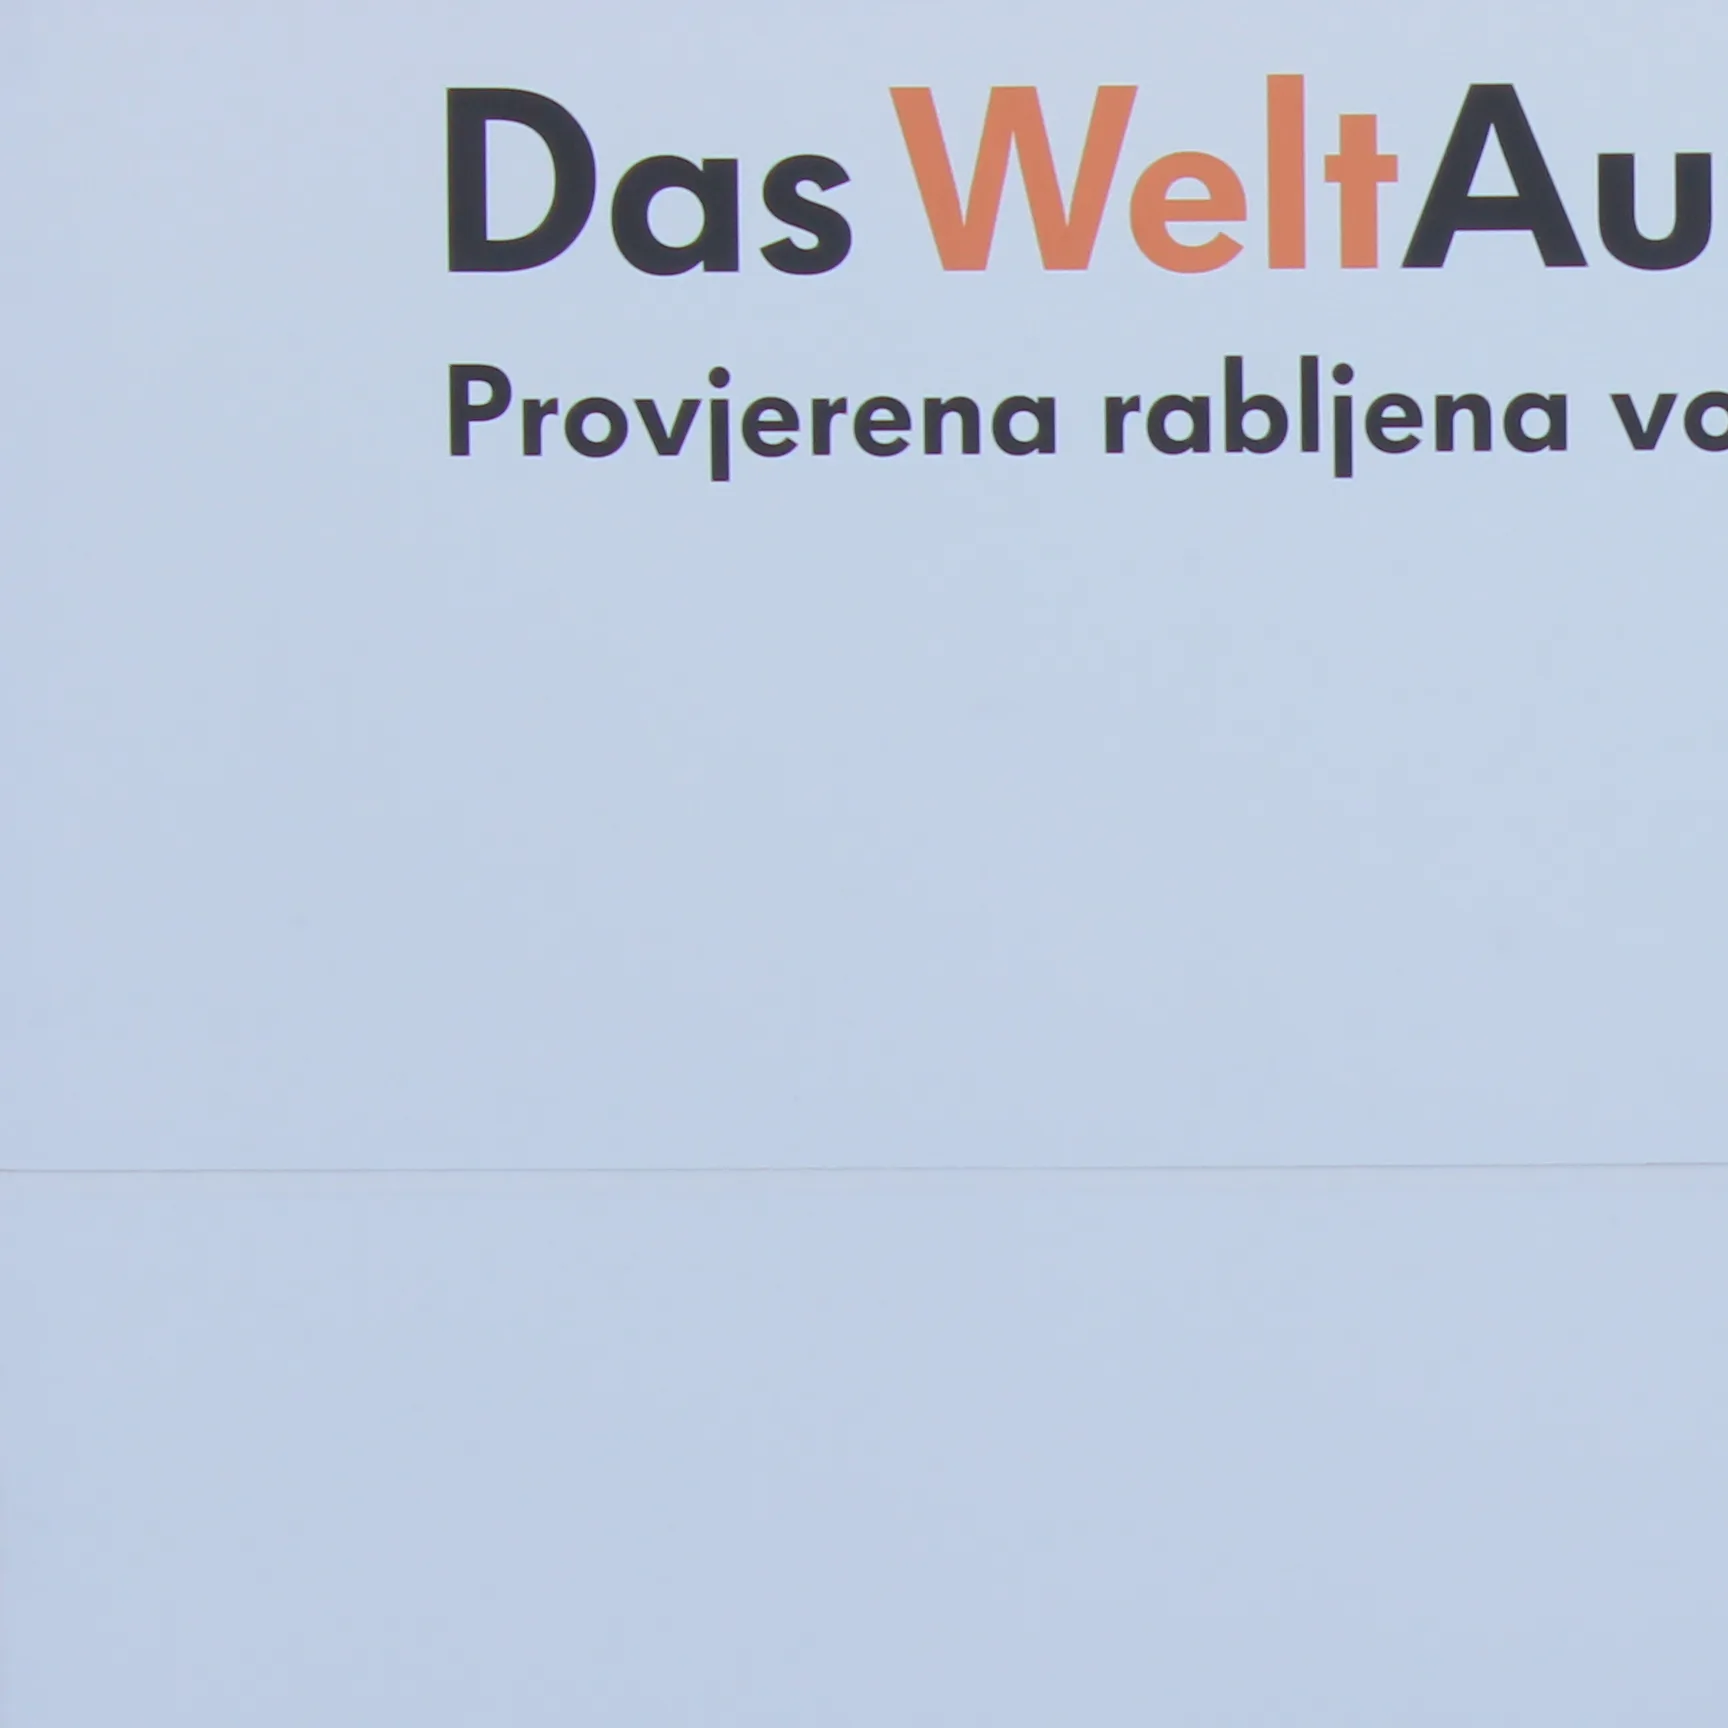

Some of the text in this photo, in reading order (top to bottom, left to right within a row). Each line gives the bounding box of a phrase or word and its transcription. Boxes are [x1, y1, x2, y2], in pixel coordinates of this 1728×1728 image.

[446, 87, 853, 277] Das
[448, 363, 1058, 483] Provjerena
[1104, 354, 1569, 480] rabljena
